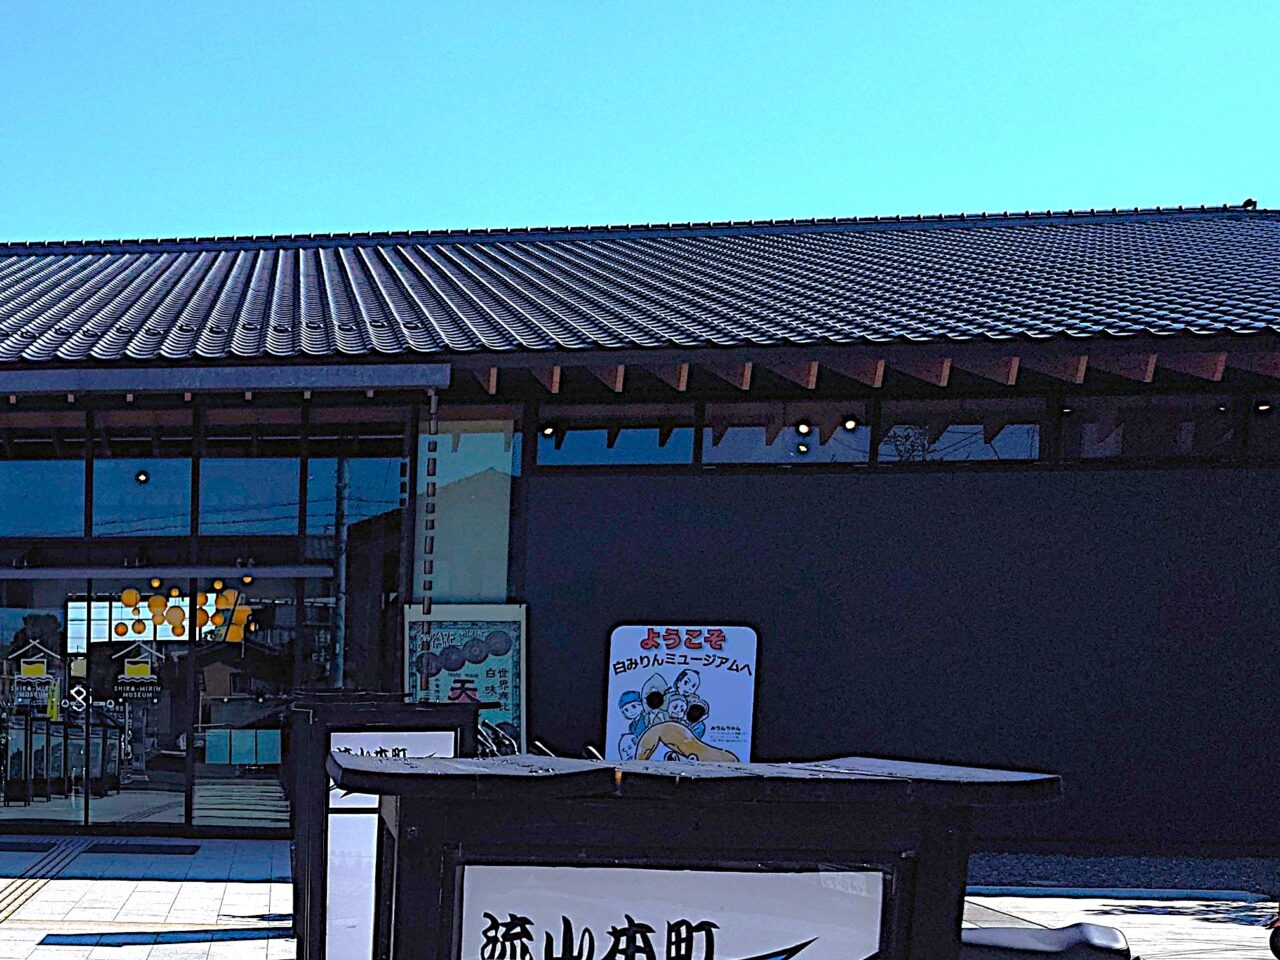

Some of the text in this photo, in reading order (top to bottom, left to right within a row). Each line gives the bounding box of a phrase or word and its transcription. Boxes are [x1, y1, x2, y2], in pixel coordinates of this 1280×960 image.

[640, 628, 726, 650] ようこそ
[613, 653, 752, 676] 白みりんミュージアムへ
[448, 679, 481, 703] 天
